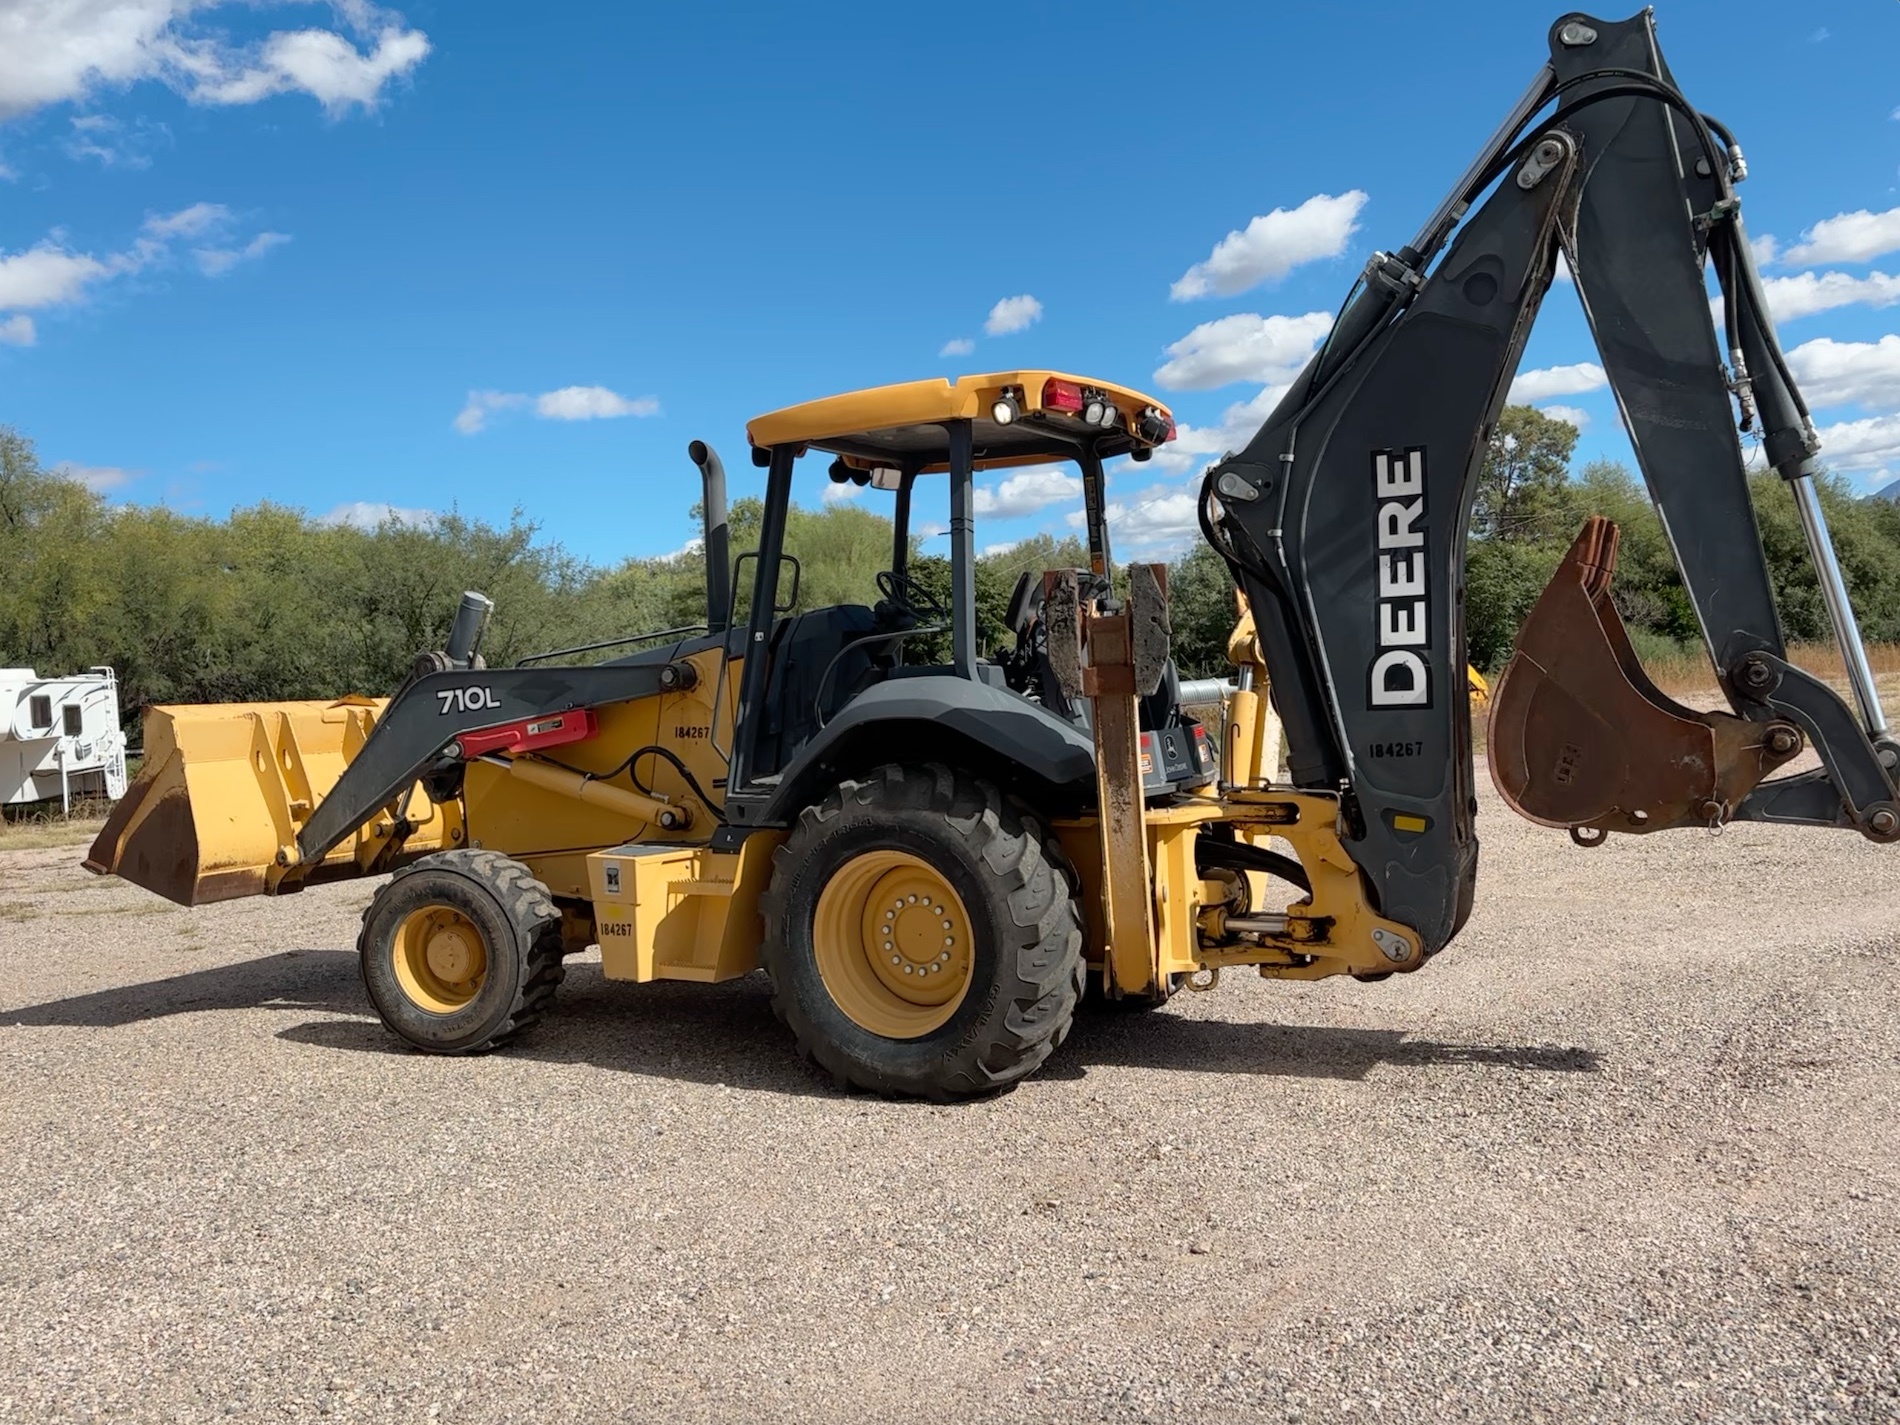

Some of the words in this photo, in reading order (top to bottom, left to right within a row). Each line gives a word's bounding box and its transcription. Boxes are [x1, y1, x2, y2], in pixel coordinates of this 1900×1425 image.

[1371, 451, 1427, 705] DEERE
[437, 685, 501, 714] 710L
[674, 726, 709, 738] 184267
[1369, 741, 1422, 758] 184267
[600, 923, 631, 936] 184267
[942, 983, 1001, 1066] GALAXY
